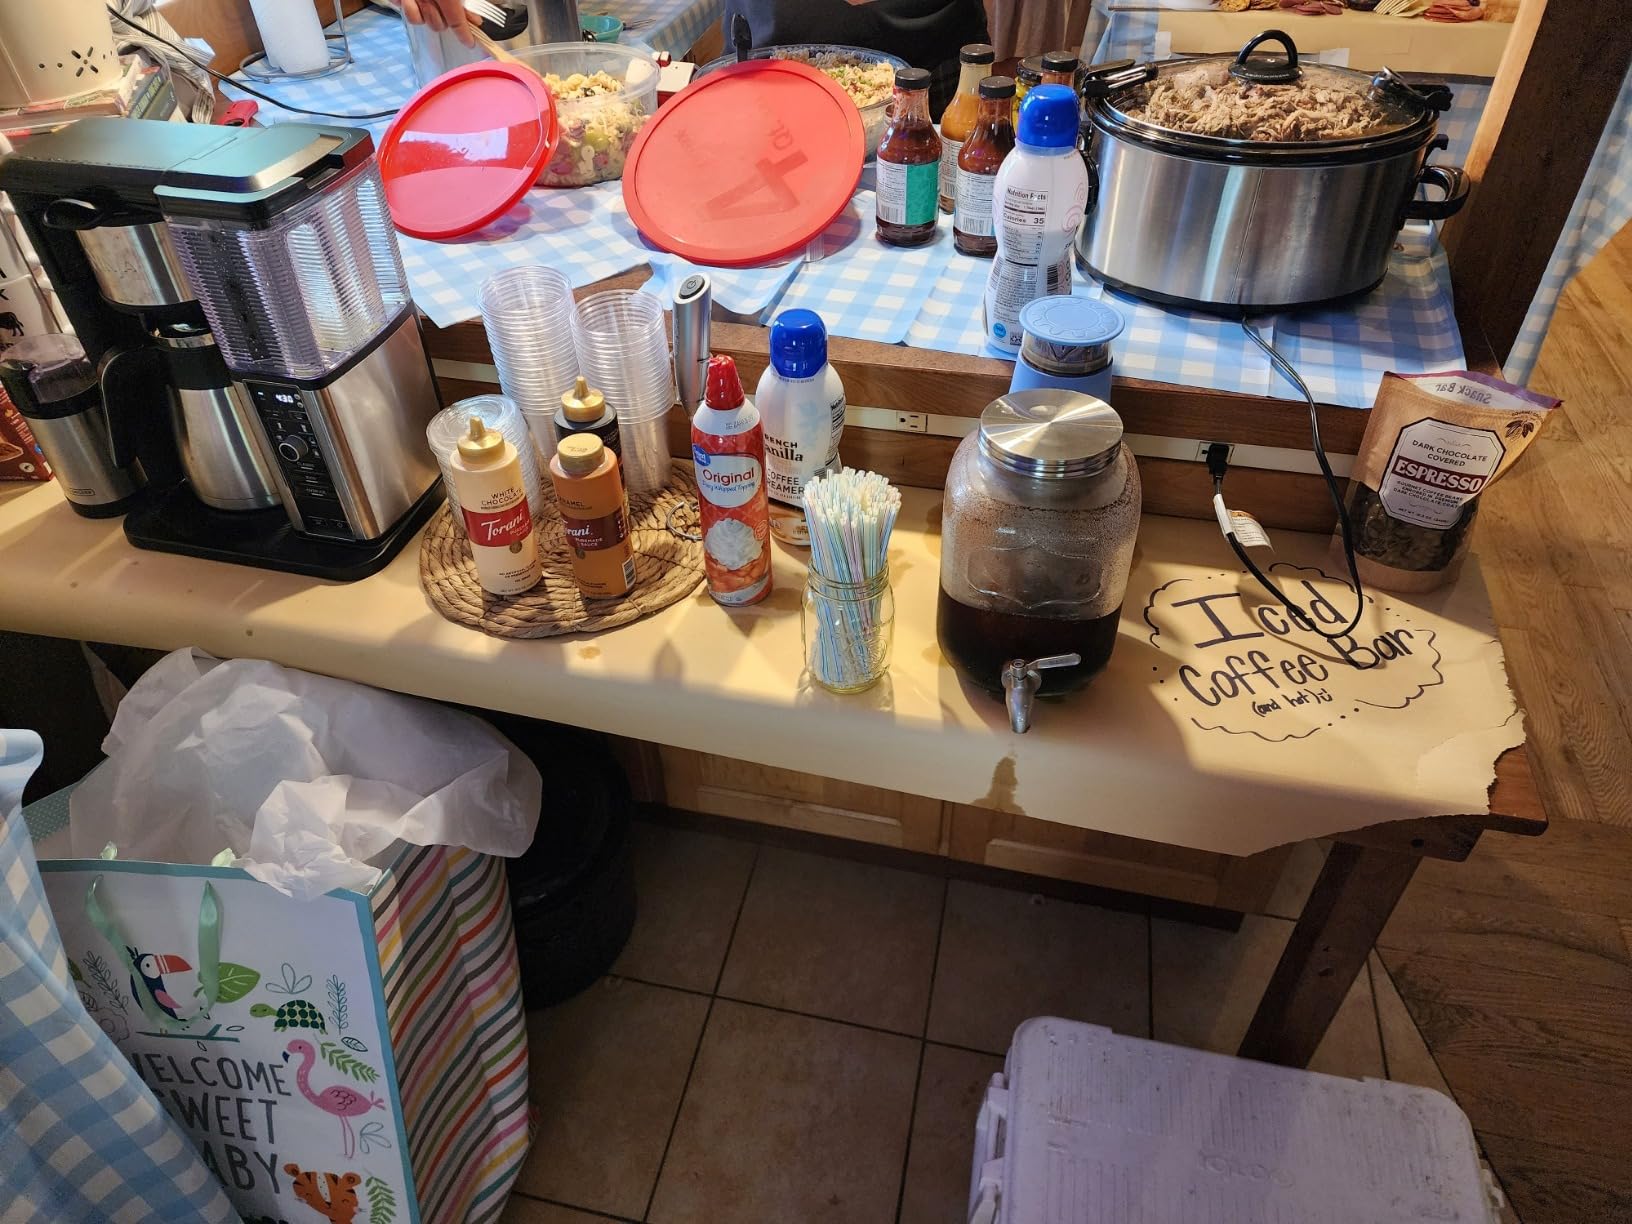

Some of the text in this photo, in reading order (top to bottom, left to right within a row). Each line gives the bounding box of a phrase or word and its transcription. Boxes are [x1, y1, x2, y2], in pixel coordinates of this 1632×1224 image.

[703, 149, 809, 220] 4
[1007, 187, 1029, 199] Nutrition
[764, 433, 798, 448] RENCH
[765, 443, 804, 461] anilla
[1412, 439, 1488, 462] DARK CHOCOLATE
[1427, 453, 1466, 467] COVERED
[702, 467, 755, 486] Original
[1394, 460, 1483, 492] ESPRESSO
[491, 487, 514, 499] WHITE
[767, 478, 805, 495] REAMER
[1393, 487, 1407, 495] DARK
[1422, 488, 1444, 497] COFFEE
[558, 497, 585, 507] ARAMEL
[480, 508, 524, 541] Torani
[1170, 579, 1350, 649] Iced
[1178, 627, 1415, 707] Coffee Bar
[153, 1087, 278, 1145] WEET
[203, 1140, 281, 1195] ABY
